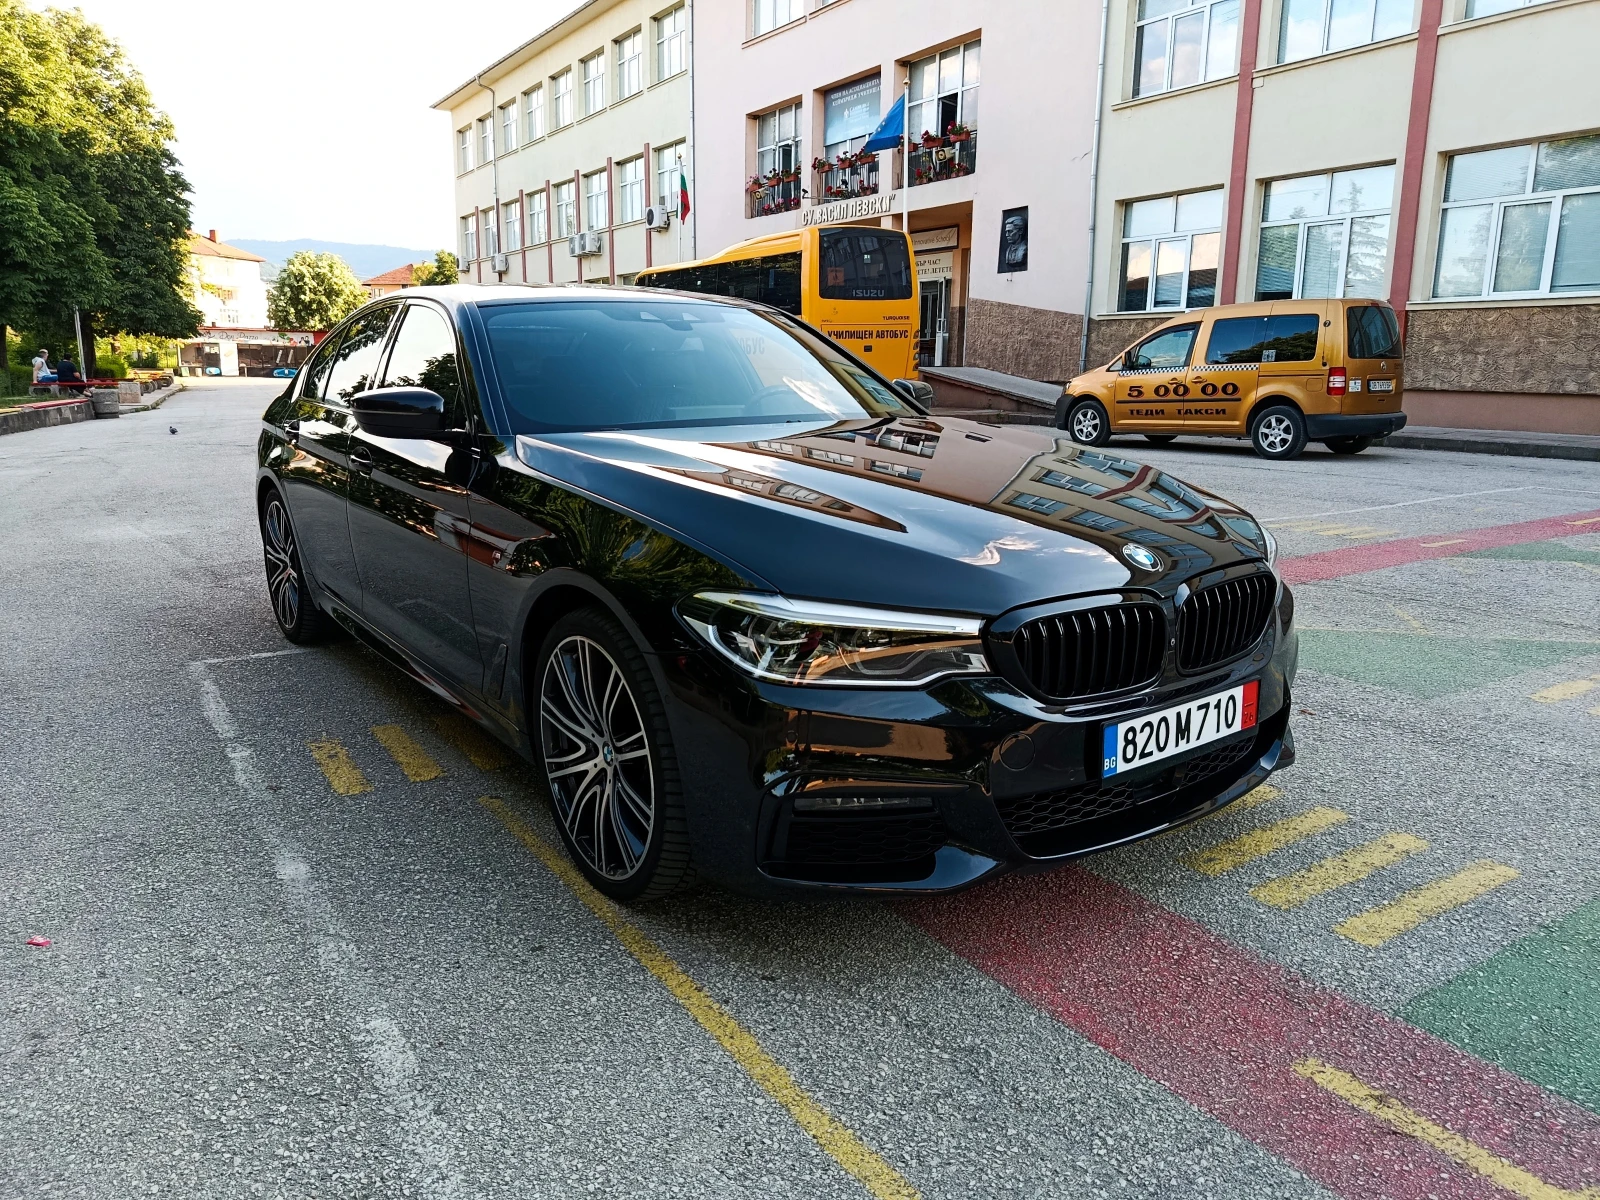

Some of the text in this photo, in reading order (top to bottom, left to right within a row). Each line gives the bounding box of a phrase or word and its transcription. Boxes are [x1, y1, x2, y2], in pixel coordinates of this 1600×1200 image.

[852, 289, 885, 297] ISUZU
[827, 329, 909, 341] УЧИЛИЩЕН АВТОБУС
[1127, 385, 1145, 398] 5
[1200, 382, 1240, 397] 00
[1128, 408, 1227, 416] ТЕДИ ТАКСИ
[1104, 756, 1117, 770] BG
